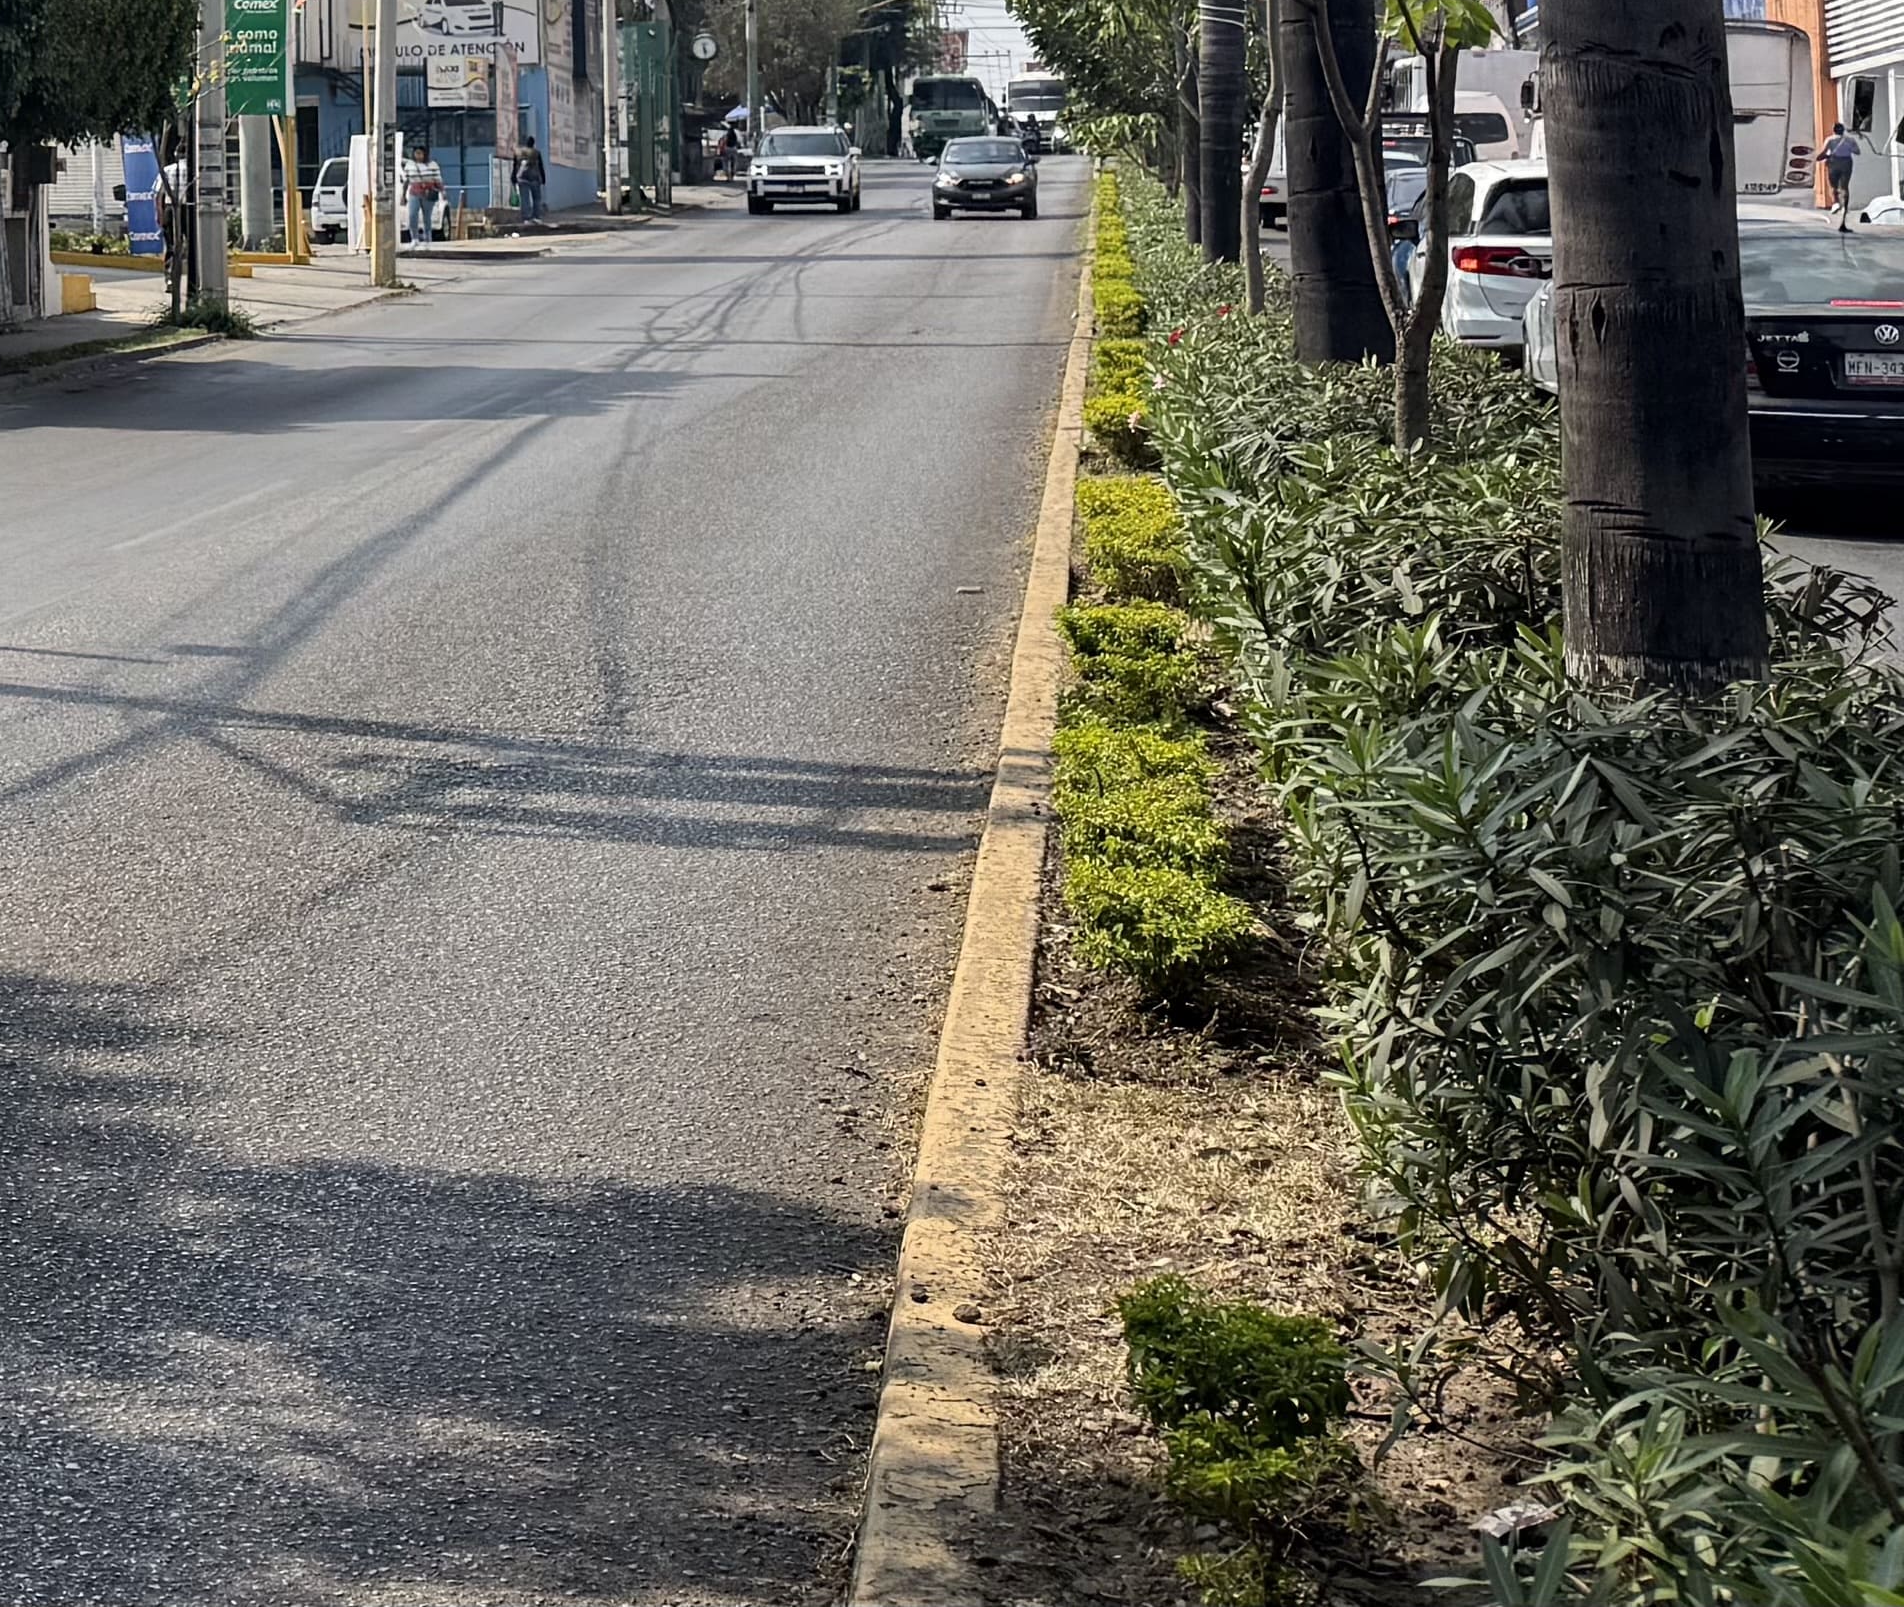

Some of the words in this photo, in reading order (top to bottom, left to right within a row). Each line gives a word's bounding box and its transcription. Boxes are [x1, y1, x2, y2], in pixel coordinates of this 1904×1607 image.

[236, 29, 278, 40] como
[427, 44, 446, 57] DE
[1757, 334, 1798, 343] JETTA
